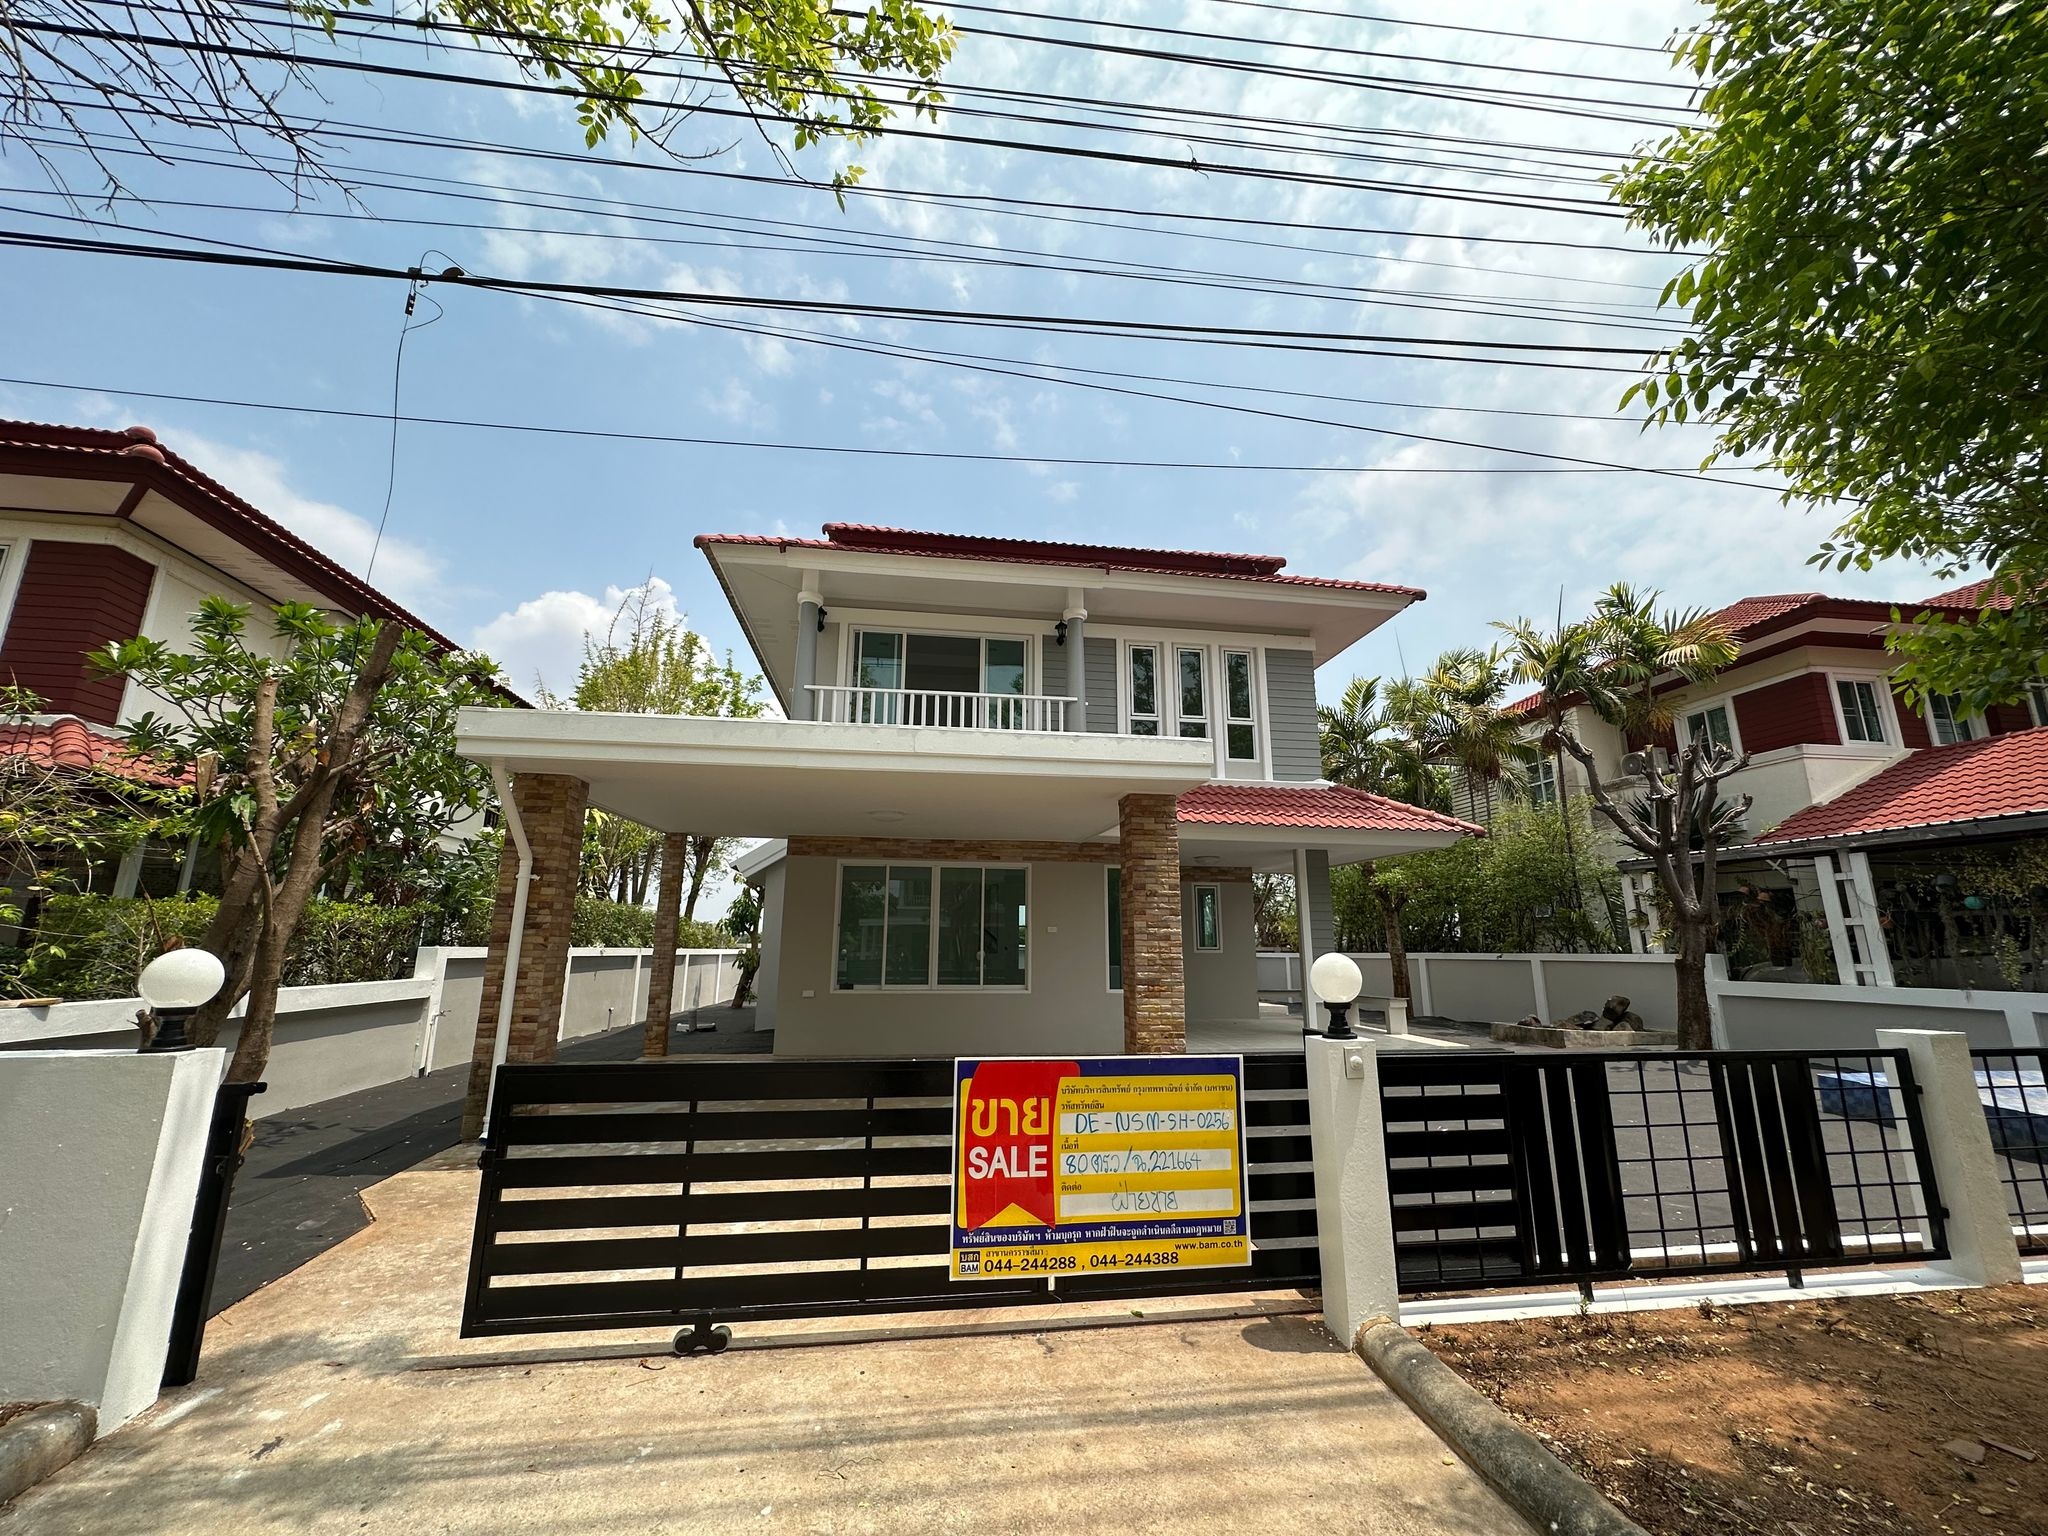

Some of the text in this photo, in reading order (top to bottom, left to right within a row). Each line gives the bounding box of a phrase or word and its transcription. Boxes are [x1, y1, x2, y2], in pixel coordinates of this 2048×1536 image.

[971, 1097, 1050, 1137] ขาย
[1061, 1137, 1079, 1150] เนื้อที่
[968, 1144, 1048, 1180] SALE
[1061, 1181, 1082, 1192] ติดต่อ
[1045, 1228, 1082, 1243] ห้ามบุกรุก
[1174, 1239, 1243, 1250] www.bam.co.th
[960, 1252, 979, 1262] บสก
[984, 1256, 1077, 1273] 044-244288
[1089, 1251, 1179, 1268] 044-244388
[960, 1262, 979, 1273] BAM
